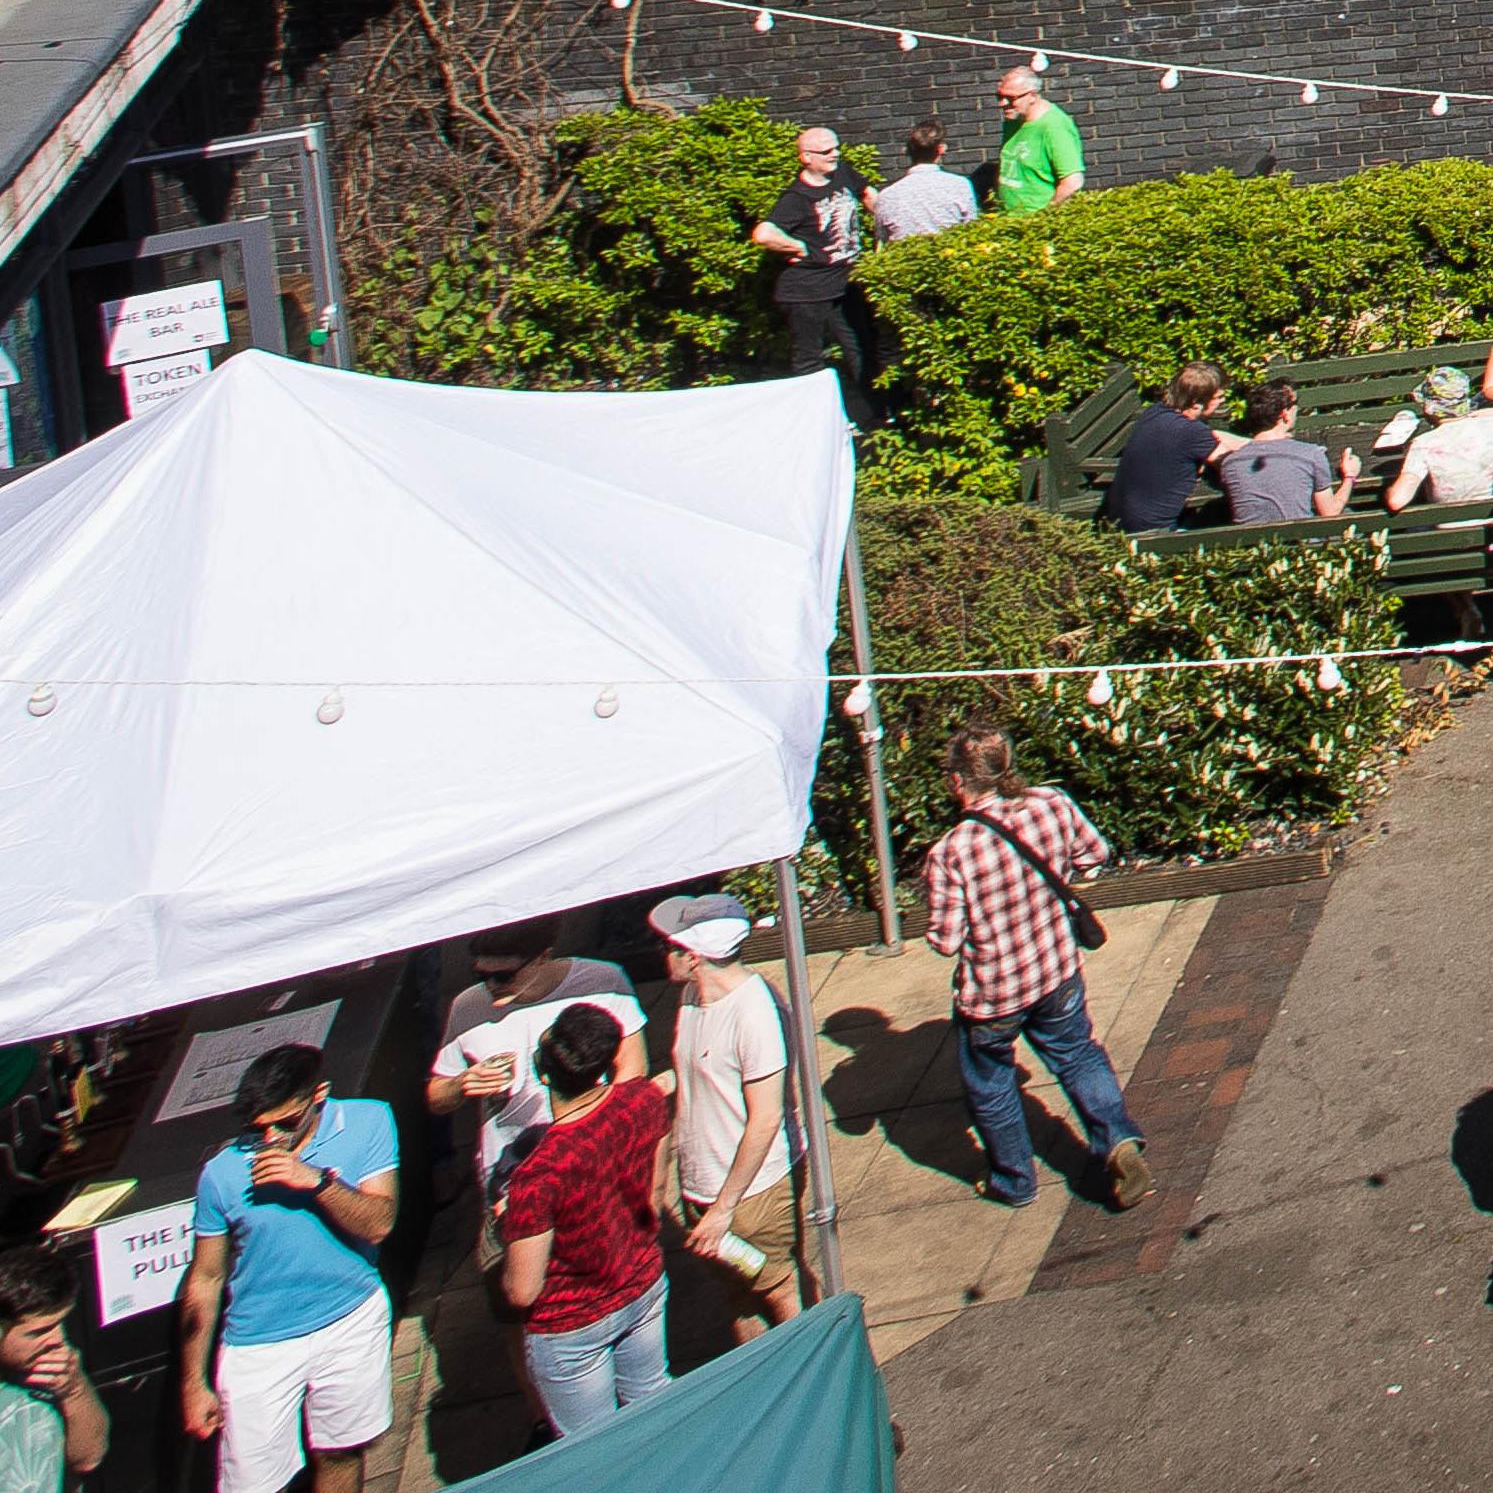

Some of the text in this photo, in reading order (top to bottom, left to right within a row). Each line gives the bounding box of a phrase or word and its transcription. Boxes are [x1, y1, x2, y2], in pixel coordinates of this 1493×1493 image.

[145, 303, 186, 320] REAL
[190, 296, 221, 311] ALE
[149, 322, 184, 338] BAR
[132, 363, 203, 386] TOKEN
[122, 1227, 173, 1254] THE
